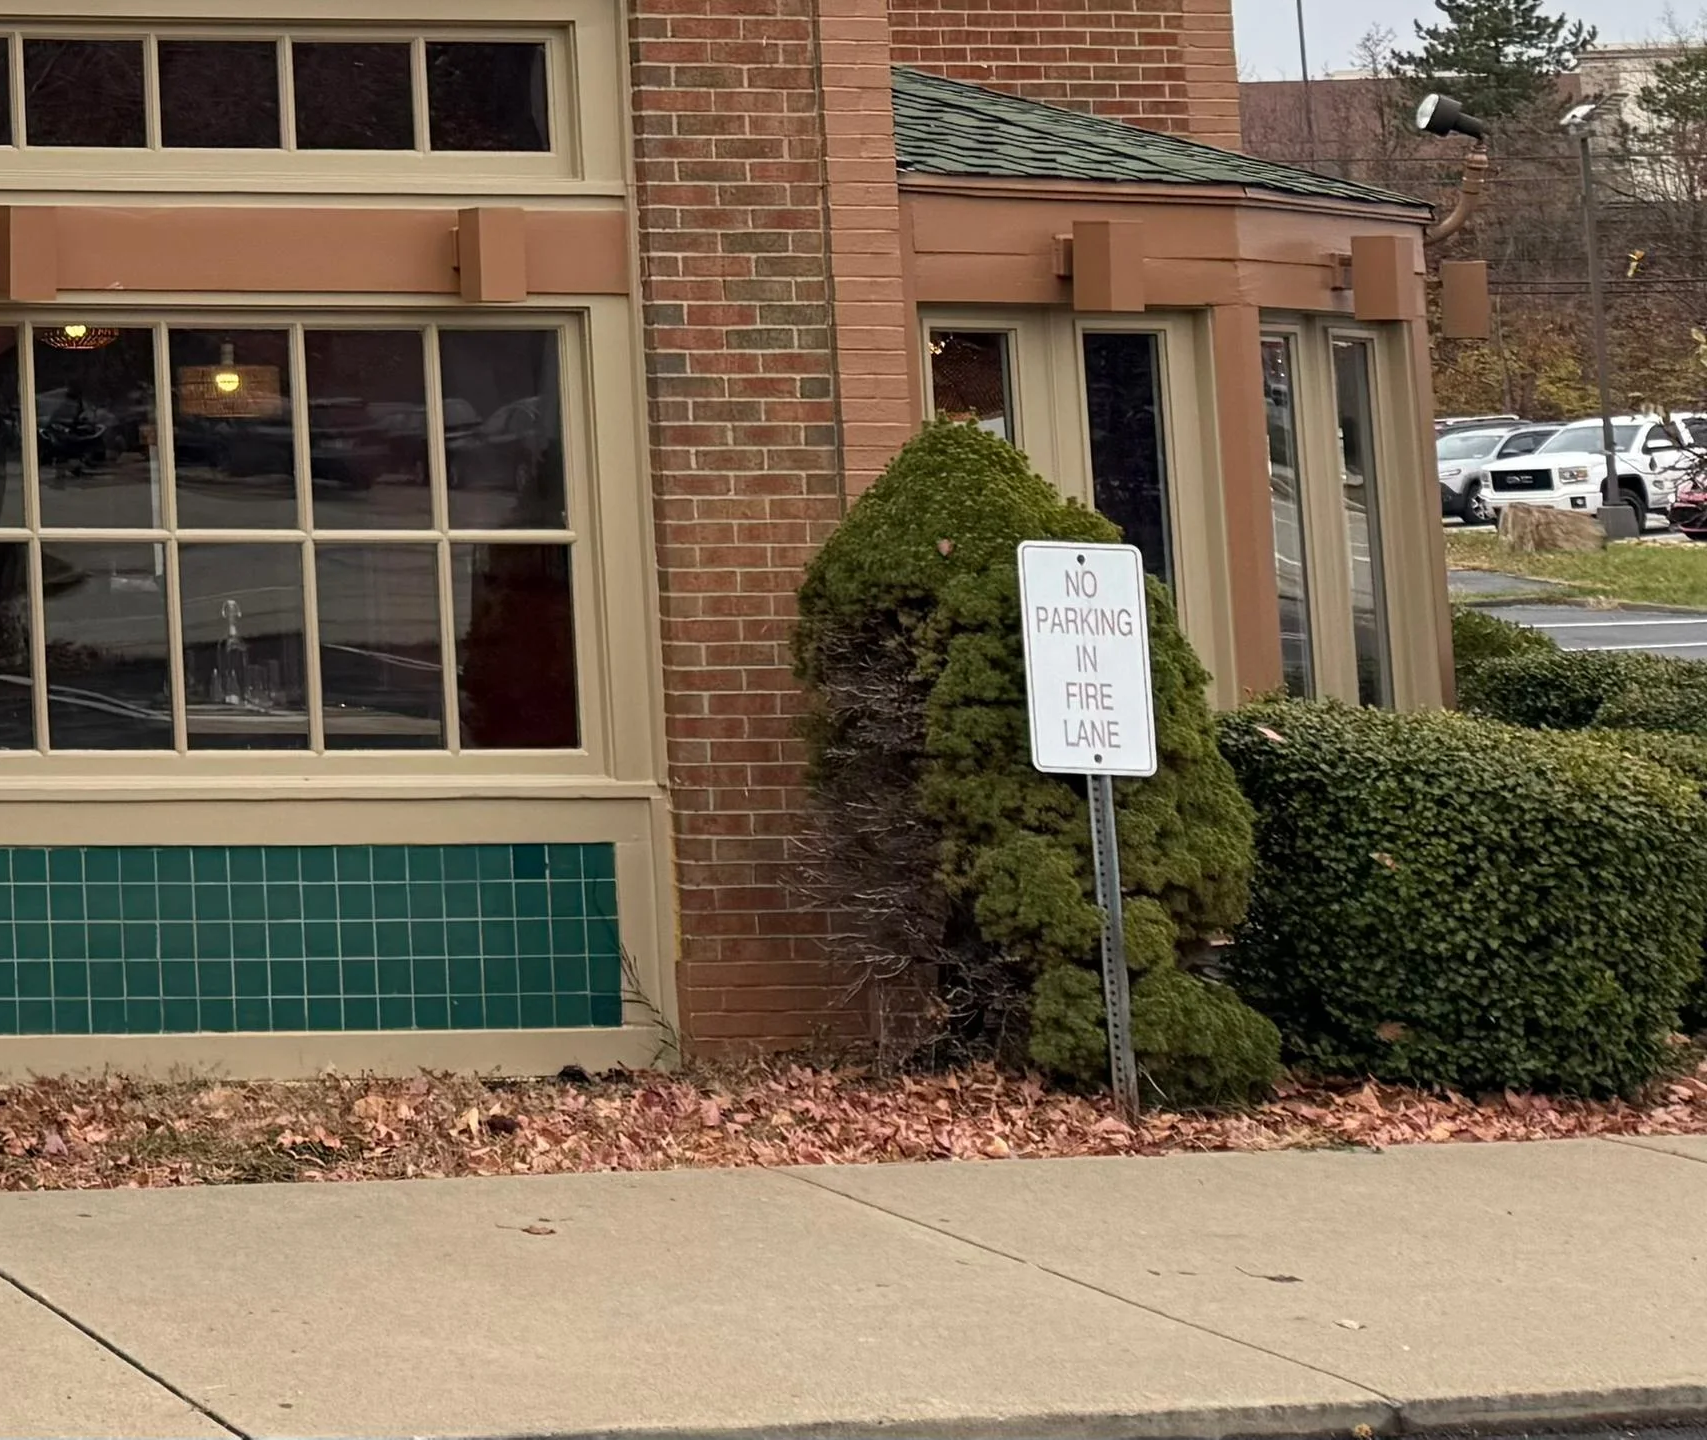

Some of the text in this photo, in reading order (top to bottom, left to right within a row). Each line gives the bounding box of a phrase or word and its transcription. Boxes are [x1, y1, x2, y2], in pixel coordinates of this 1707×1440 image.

[1064, 569, 1098, 599] NO
[1035, 606, 1134, 637] PARKING
[1075, 645, 1098, 673] IN
[1065, 681, 1114, 711] FIRE
[1062, 718, 1122, 749] LANE
